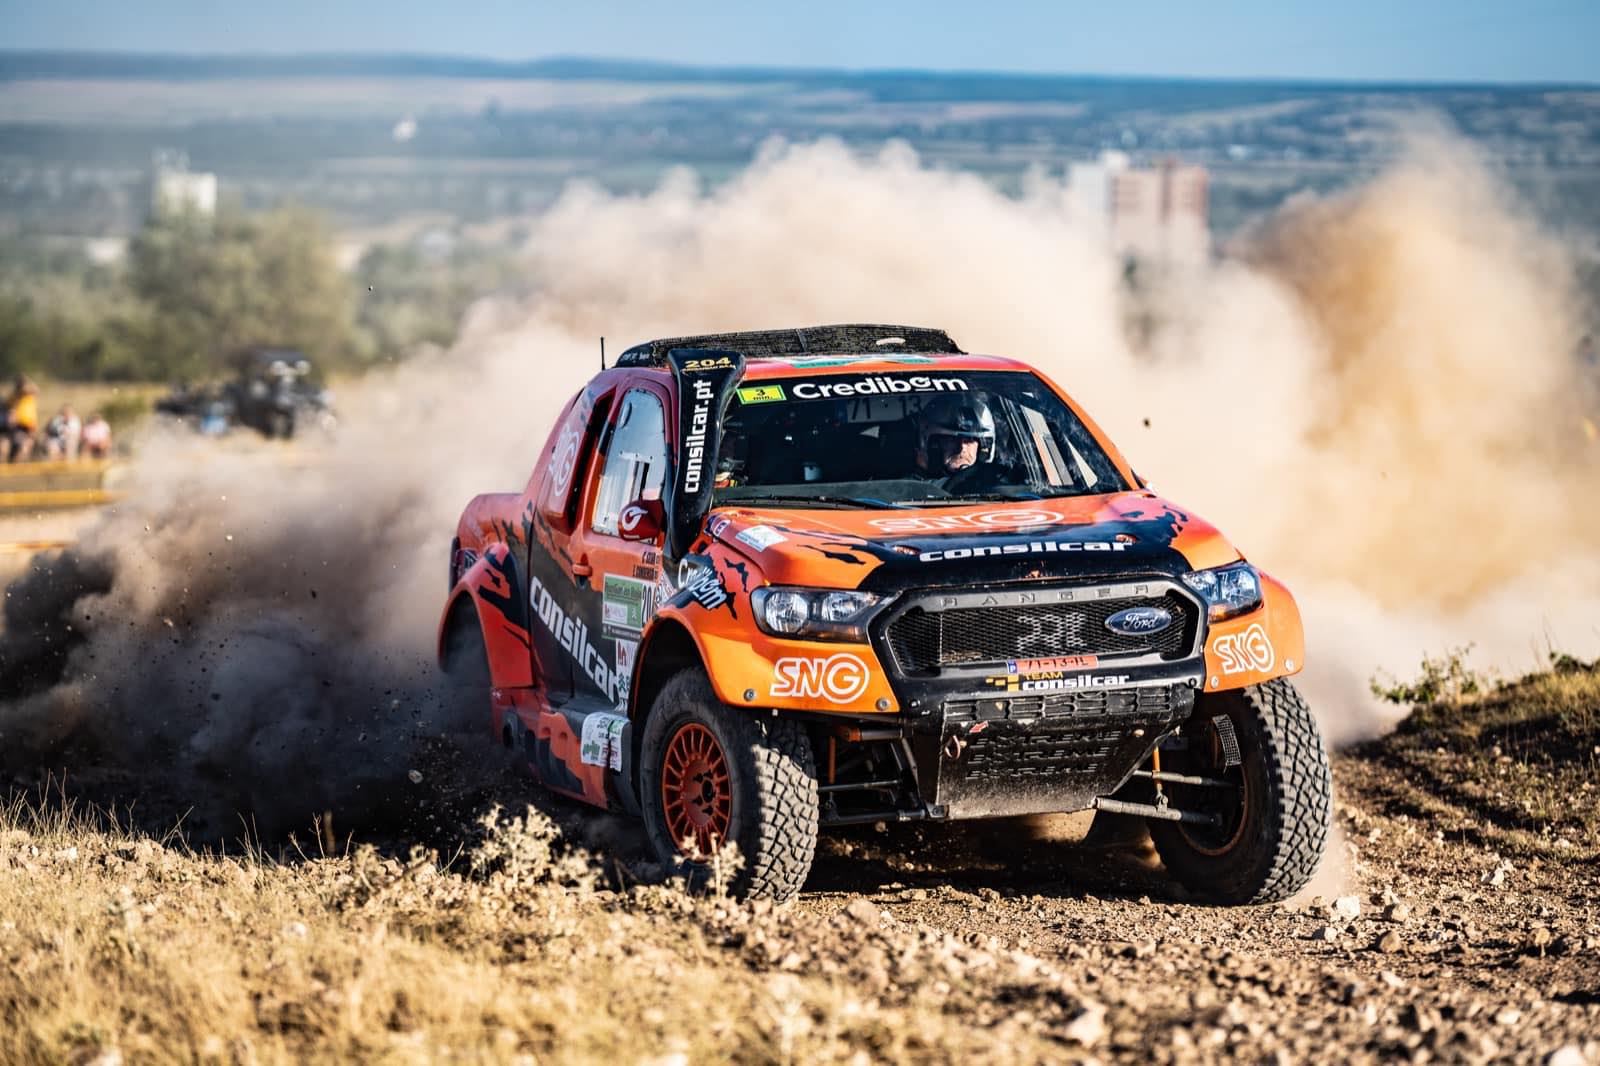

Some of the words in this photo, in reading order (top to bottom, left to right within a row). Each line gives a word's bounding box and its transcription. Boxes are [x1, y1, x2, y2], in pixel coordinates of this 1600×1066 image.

[685, 357, 732, 369] 204
[792, 376, 969, 399] Credibom
[684, 379, 714, 493] consilcar.pt
[868, 509, 1064, 532] SNG
[919, 541, 1133, 562] consilcar
[940, 584, 1149, 608] RANGER
[1123, 612, 1157, 630] Ford
[530, 575, 621, 703] consilcar
[1213, 623, 1275, 674] SNG
[769, 653, 870, 704] SNG
[1022, 675, 1130, 691] consilcar
[1024, 671, 1064, 680] TEAM
